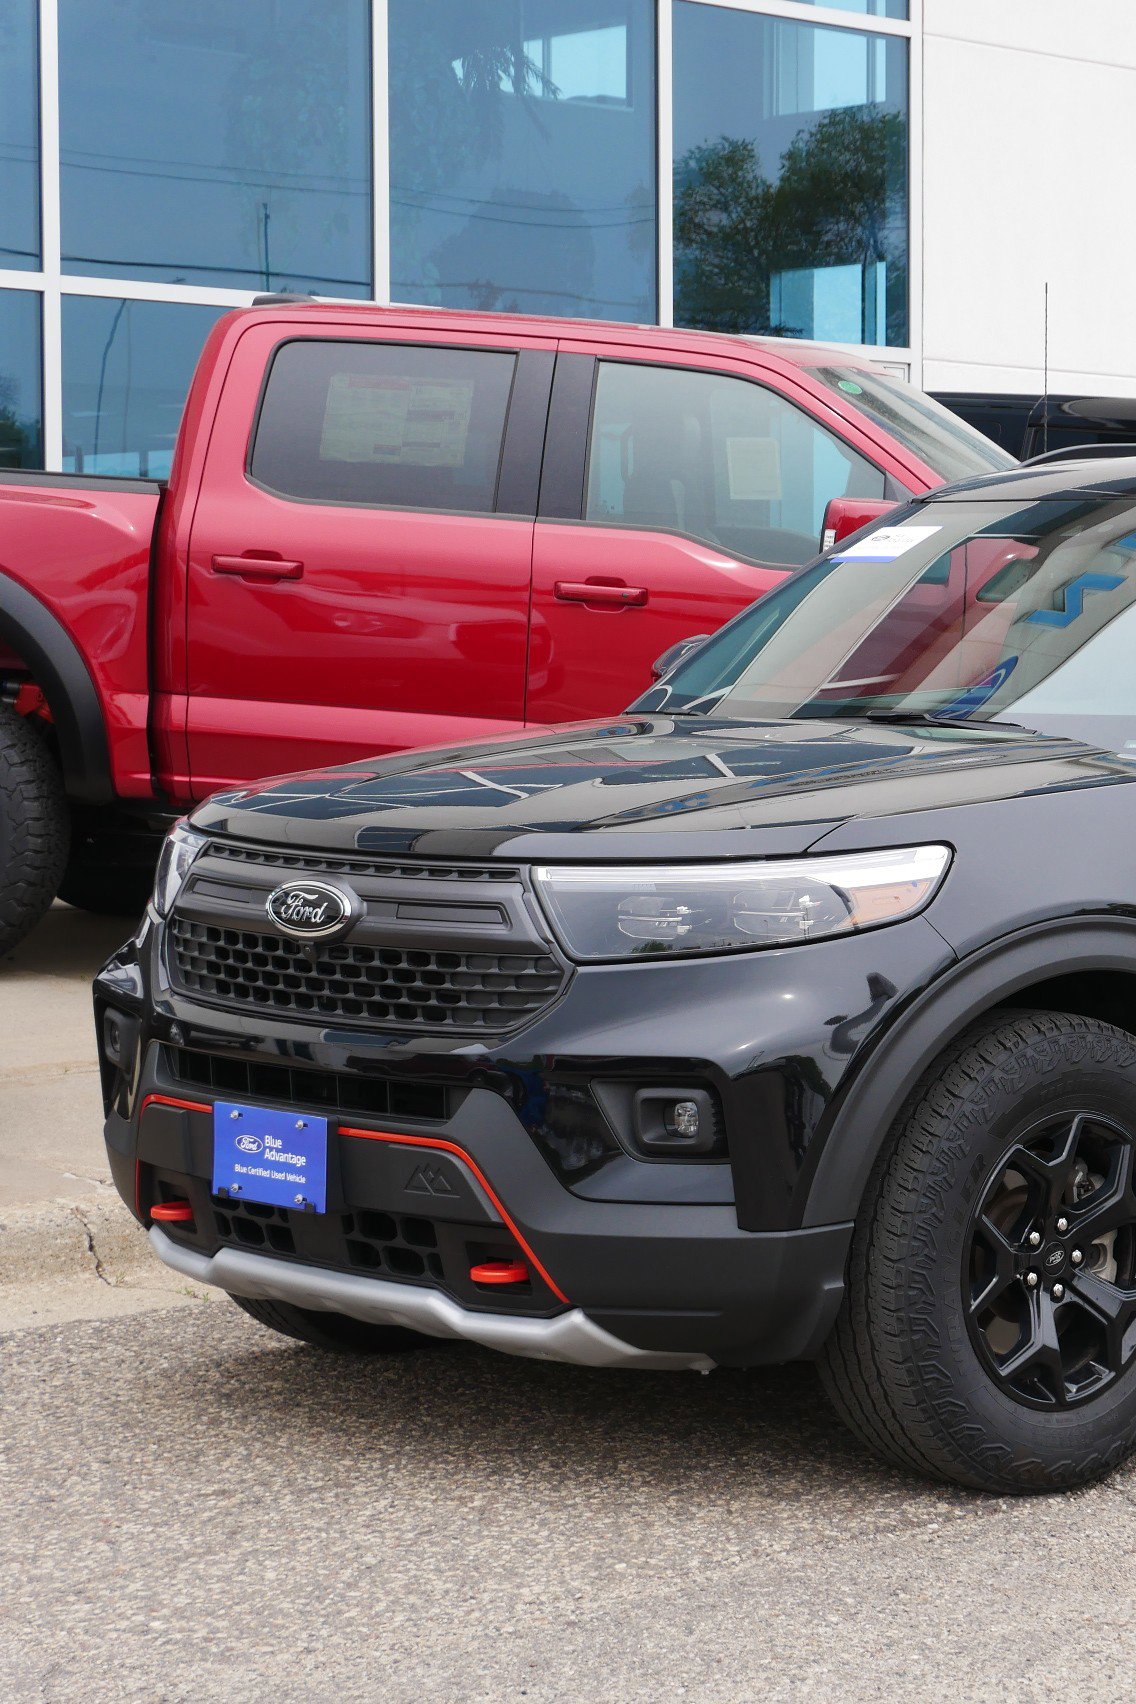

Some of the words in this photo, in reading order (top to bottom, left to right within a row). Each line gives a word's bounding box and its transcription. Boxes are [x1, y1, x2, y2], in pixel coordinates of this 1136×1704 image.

[281, 891, 328, 923] Ford
[240, 1136, 258, 1150] Ford
[264, 1135, 282, 1149] Blue
[264, 1149, 306, 1166] Advantage
[234, 1164, 247, 1174] Blue
[248, 1166, 270, 1178] Certified
[271, 1170, 286, 1181] Used
[286, 1172, 306, 1184] Vehicle
